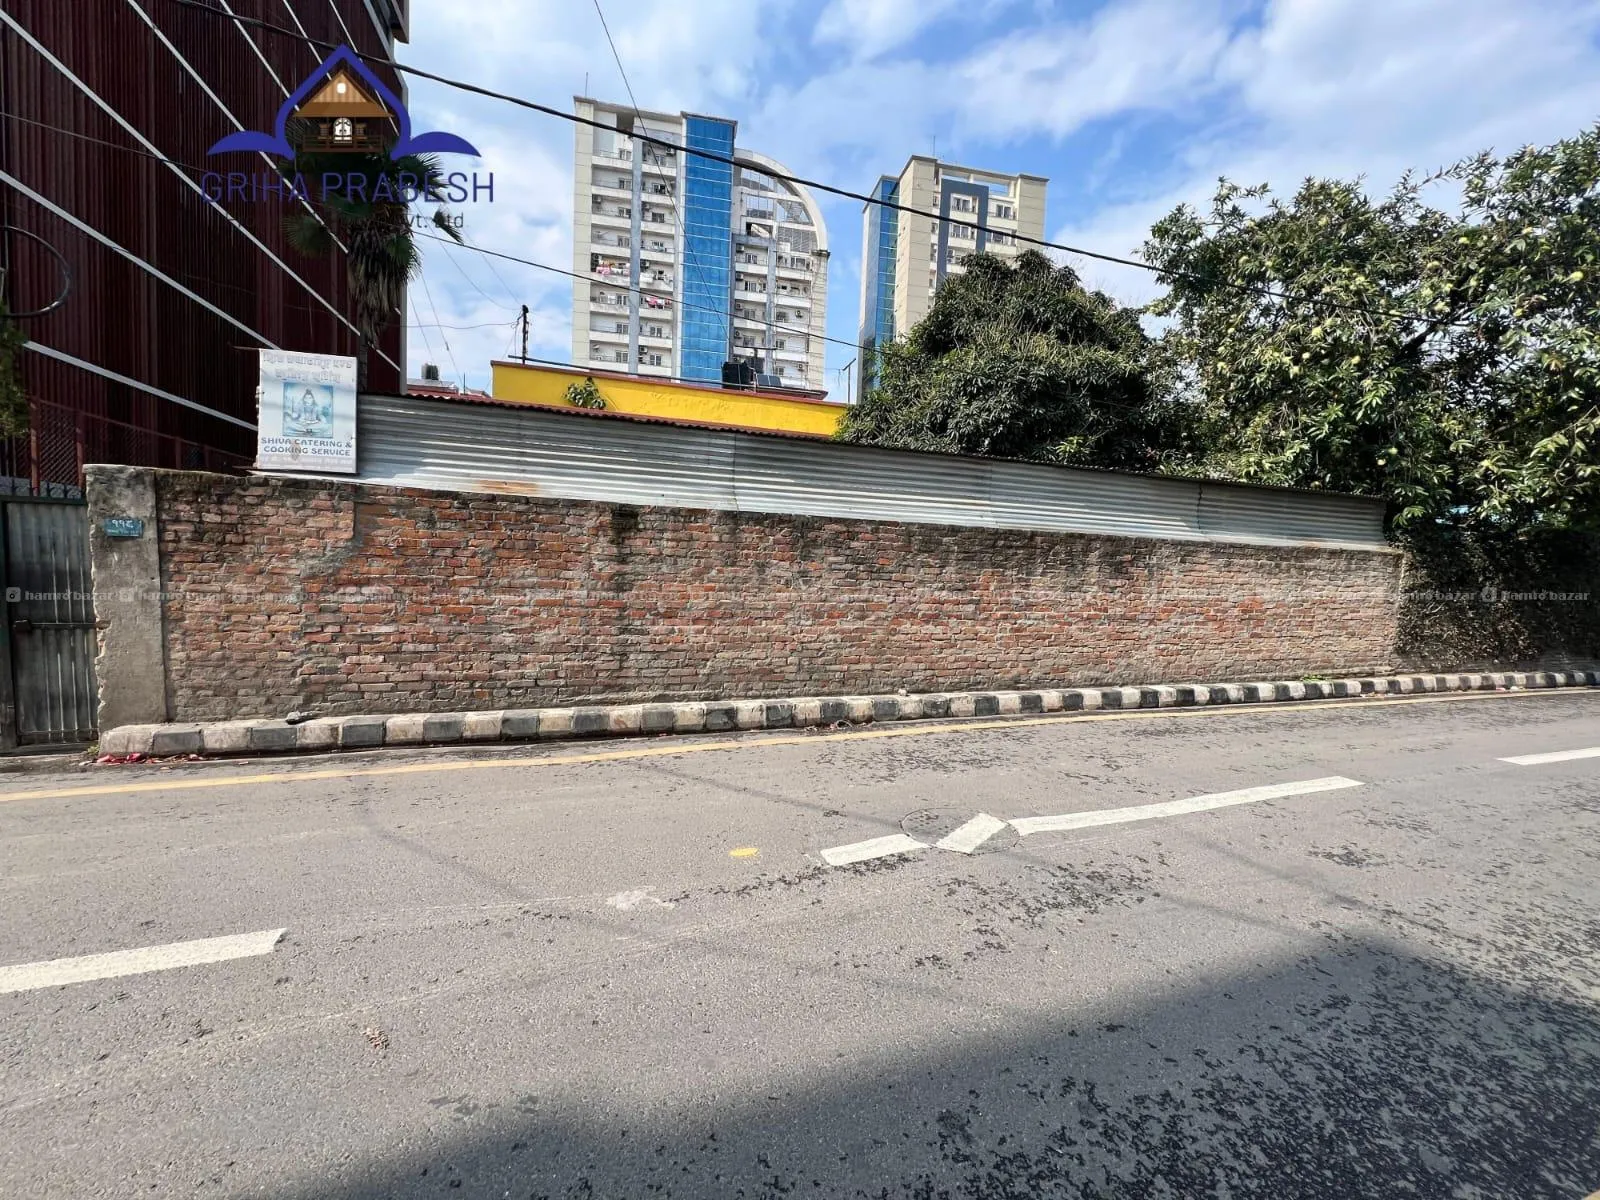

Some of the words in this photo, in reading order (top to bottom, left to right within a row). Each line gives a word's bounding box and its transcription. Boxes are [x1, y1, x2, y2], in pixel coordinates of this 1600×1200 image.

[261, 437, 291, 445] SHIVA
[294, 439, 343, 448] CATERING
[263, 446, 308, 454] COOKING
[311, 447, 351, 456] SERVICE
